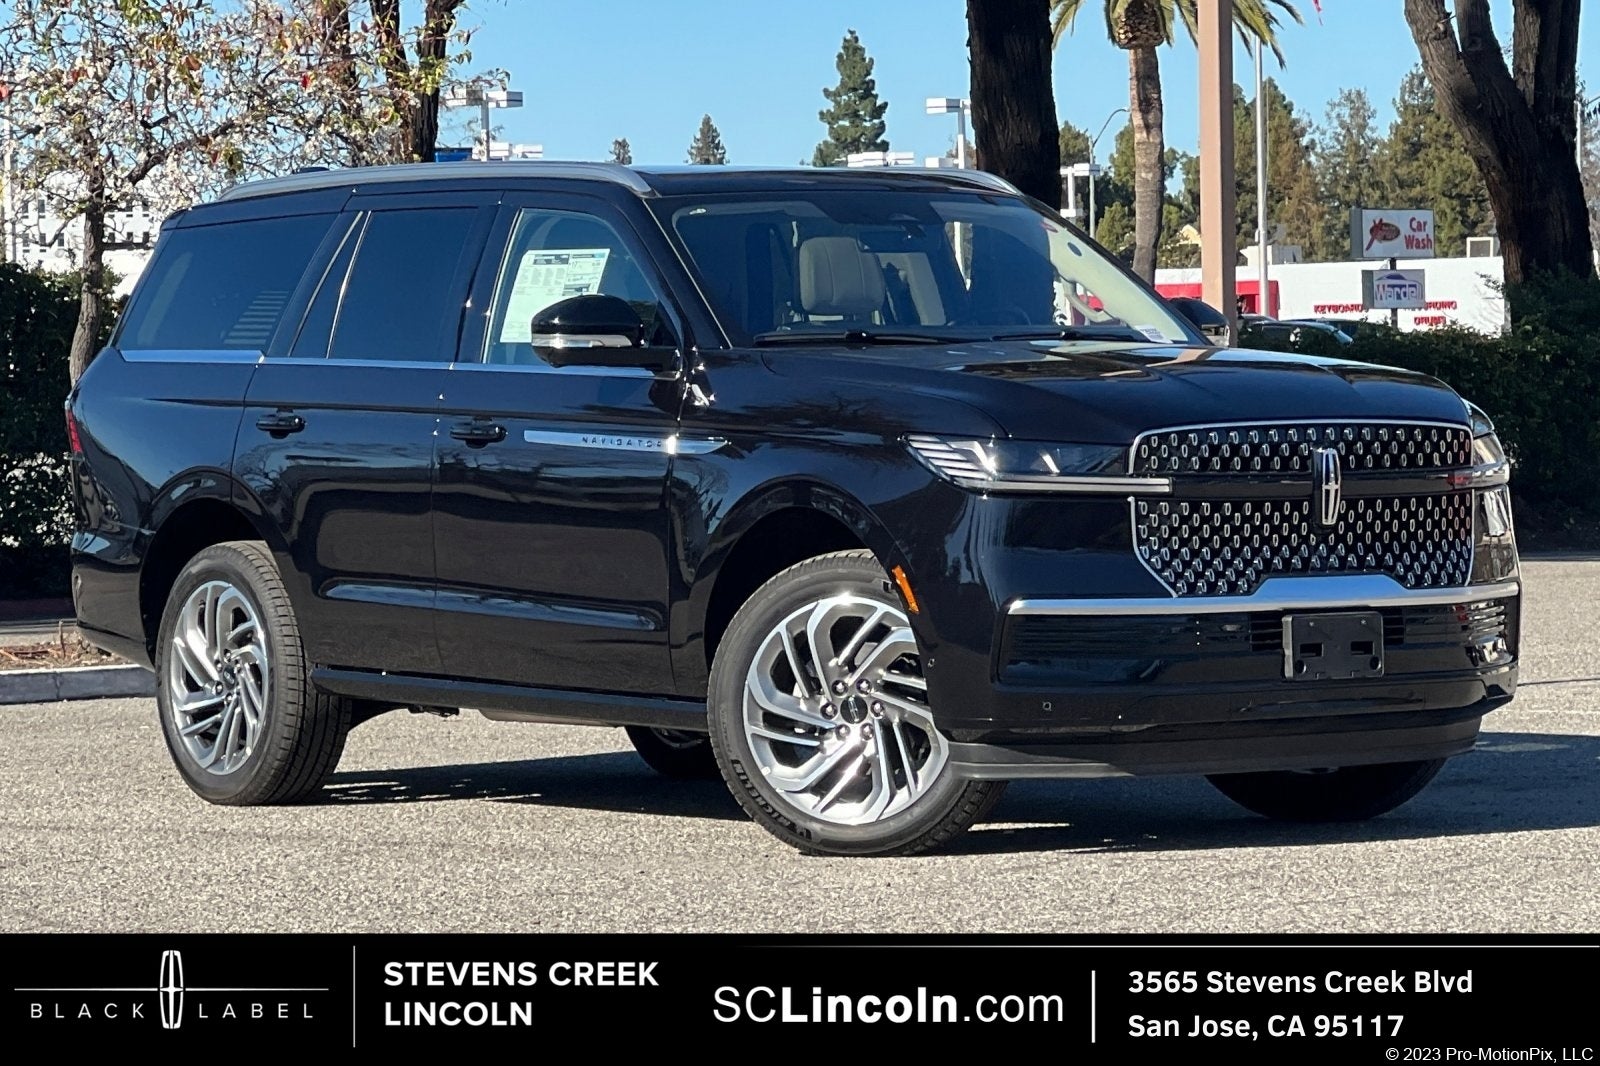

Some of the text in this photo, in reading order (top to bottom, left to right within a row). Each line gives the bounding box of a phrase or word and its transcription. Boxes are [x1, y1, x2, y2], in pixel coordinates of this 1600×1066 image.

[1409, 217, 1428, 232] Car
[1404, 234, 1433, 250] Wash
[1313, 303, 1369, 314] KEYBOARD
